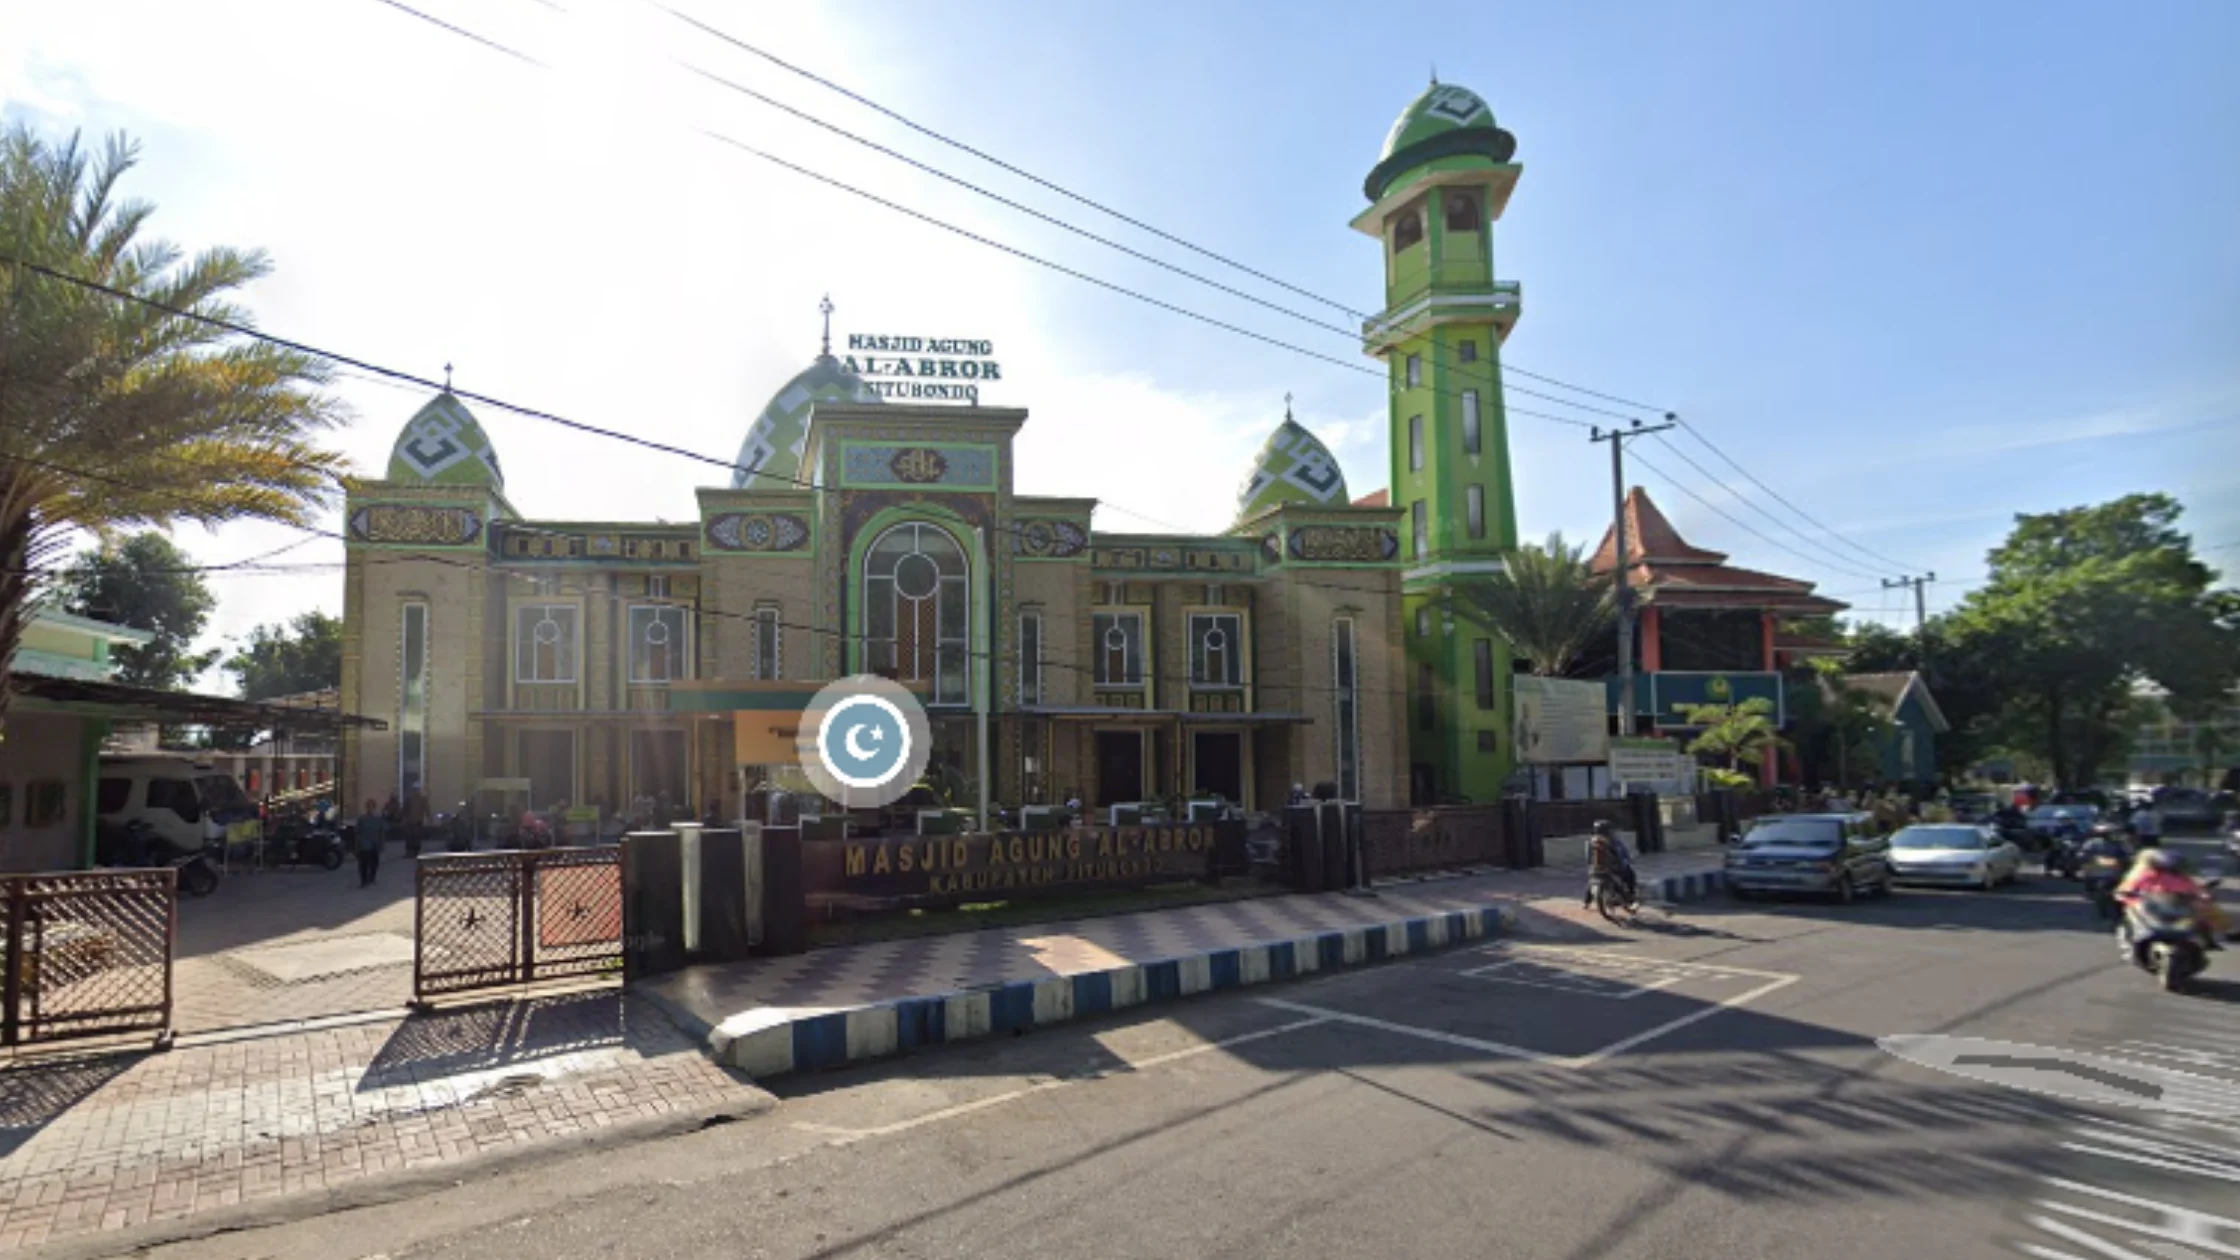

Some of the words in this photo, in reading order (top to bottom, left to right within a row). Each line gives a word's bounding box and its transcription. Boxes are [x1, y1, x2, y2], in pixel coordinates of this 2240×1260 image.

[848, 333, 922, 352] MASJID
[926, 337, 994, 356] AGUNG
[845, 839, 968, 877] MASJID
[989, 831, 1081, 866] AGUNG
